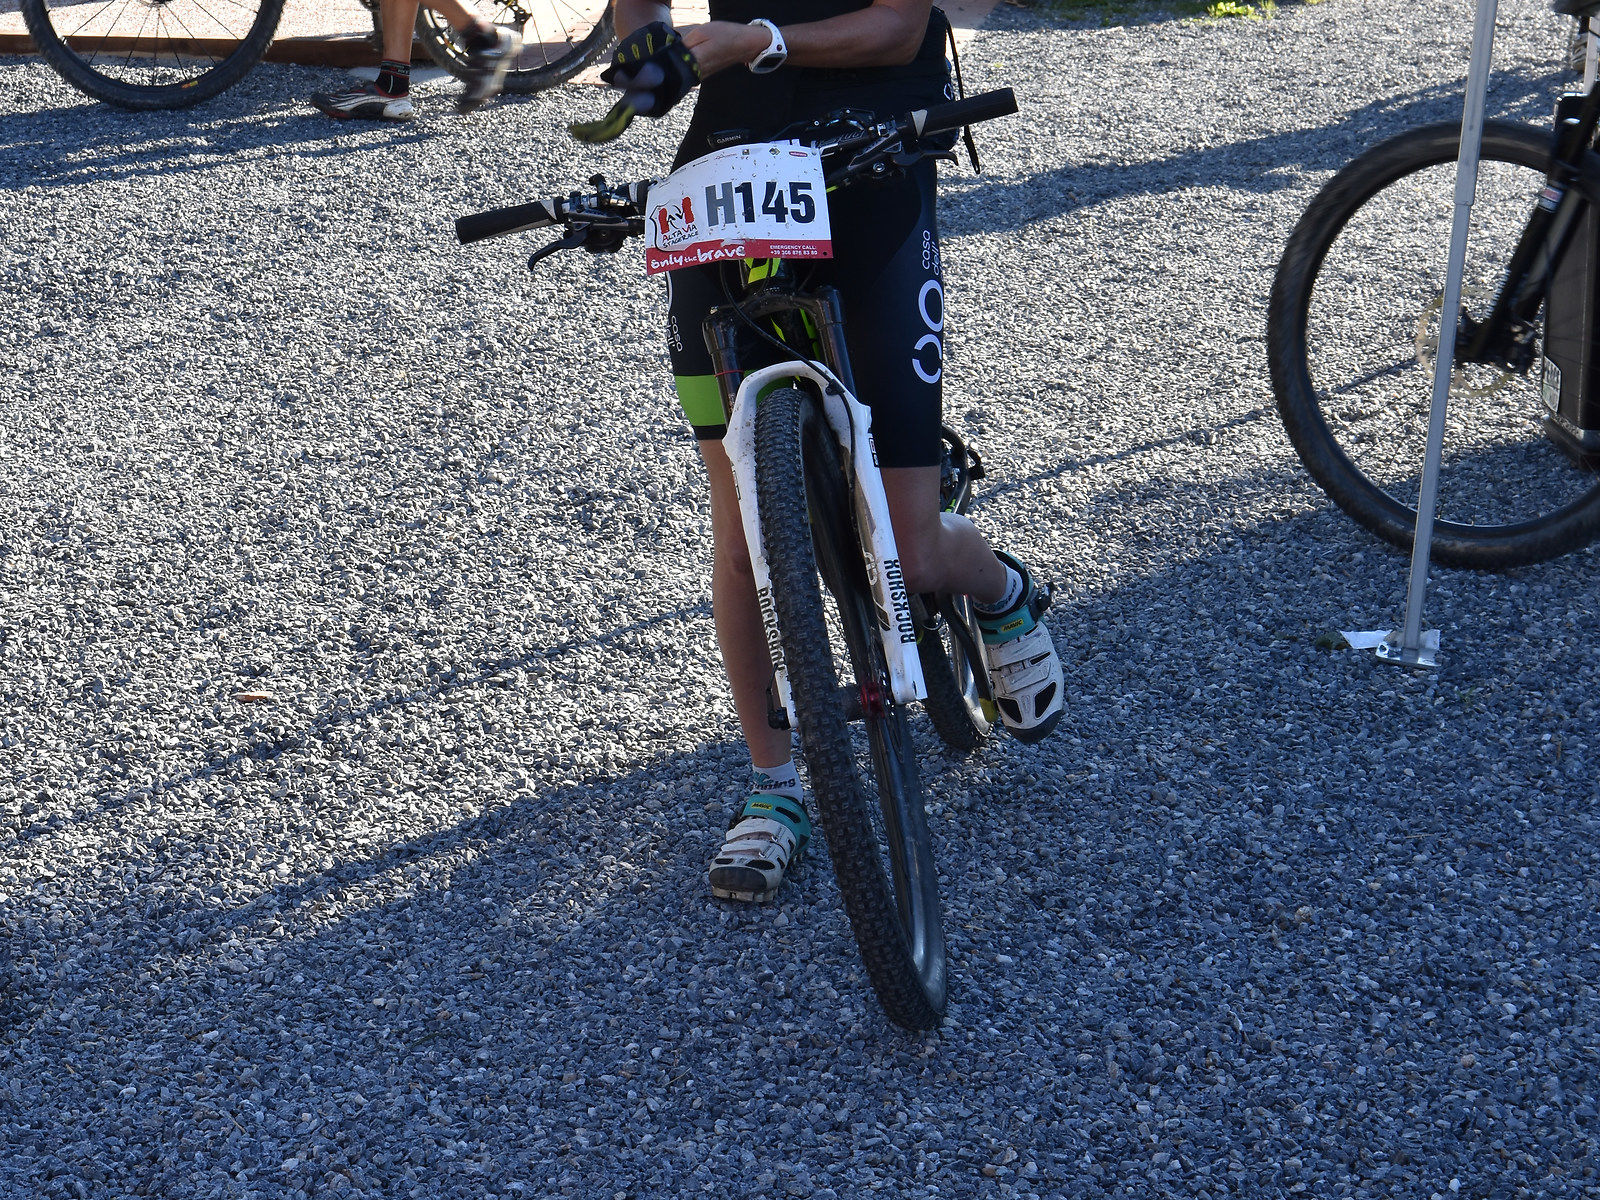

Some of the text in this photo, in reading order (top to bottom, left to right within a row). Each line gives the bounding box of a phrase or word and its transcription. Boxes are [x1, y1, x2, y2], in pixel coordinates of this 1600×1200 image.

[716, 135, 741, 144] GARMIN
[705, 181, 817, 227] H145
[650, 253, 683, 270] only
[696, 243, 746, 263] brave
[883, 558, 916, 644] ROCKSHOX
